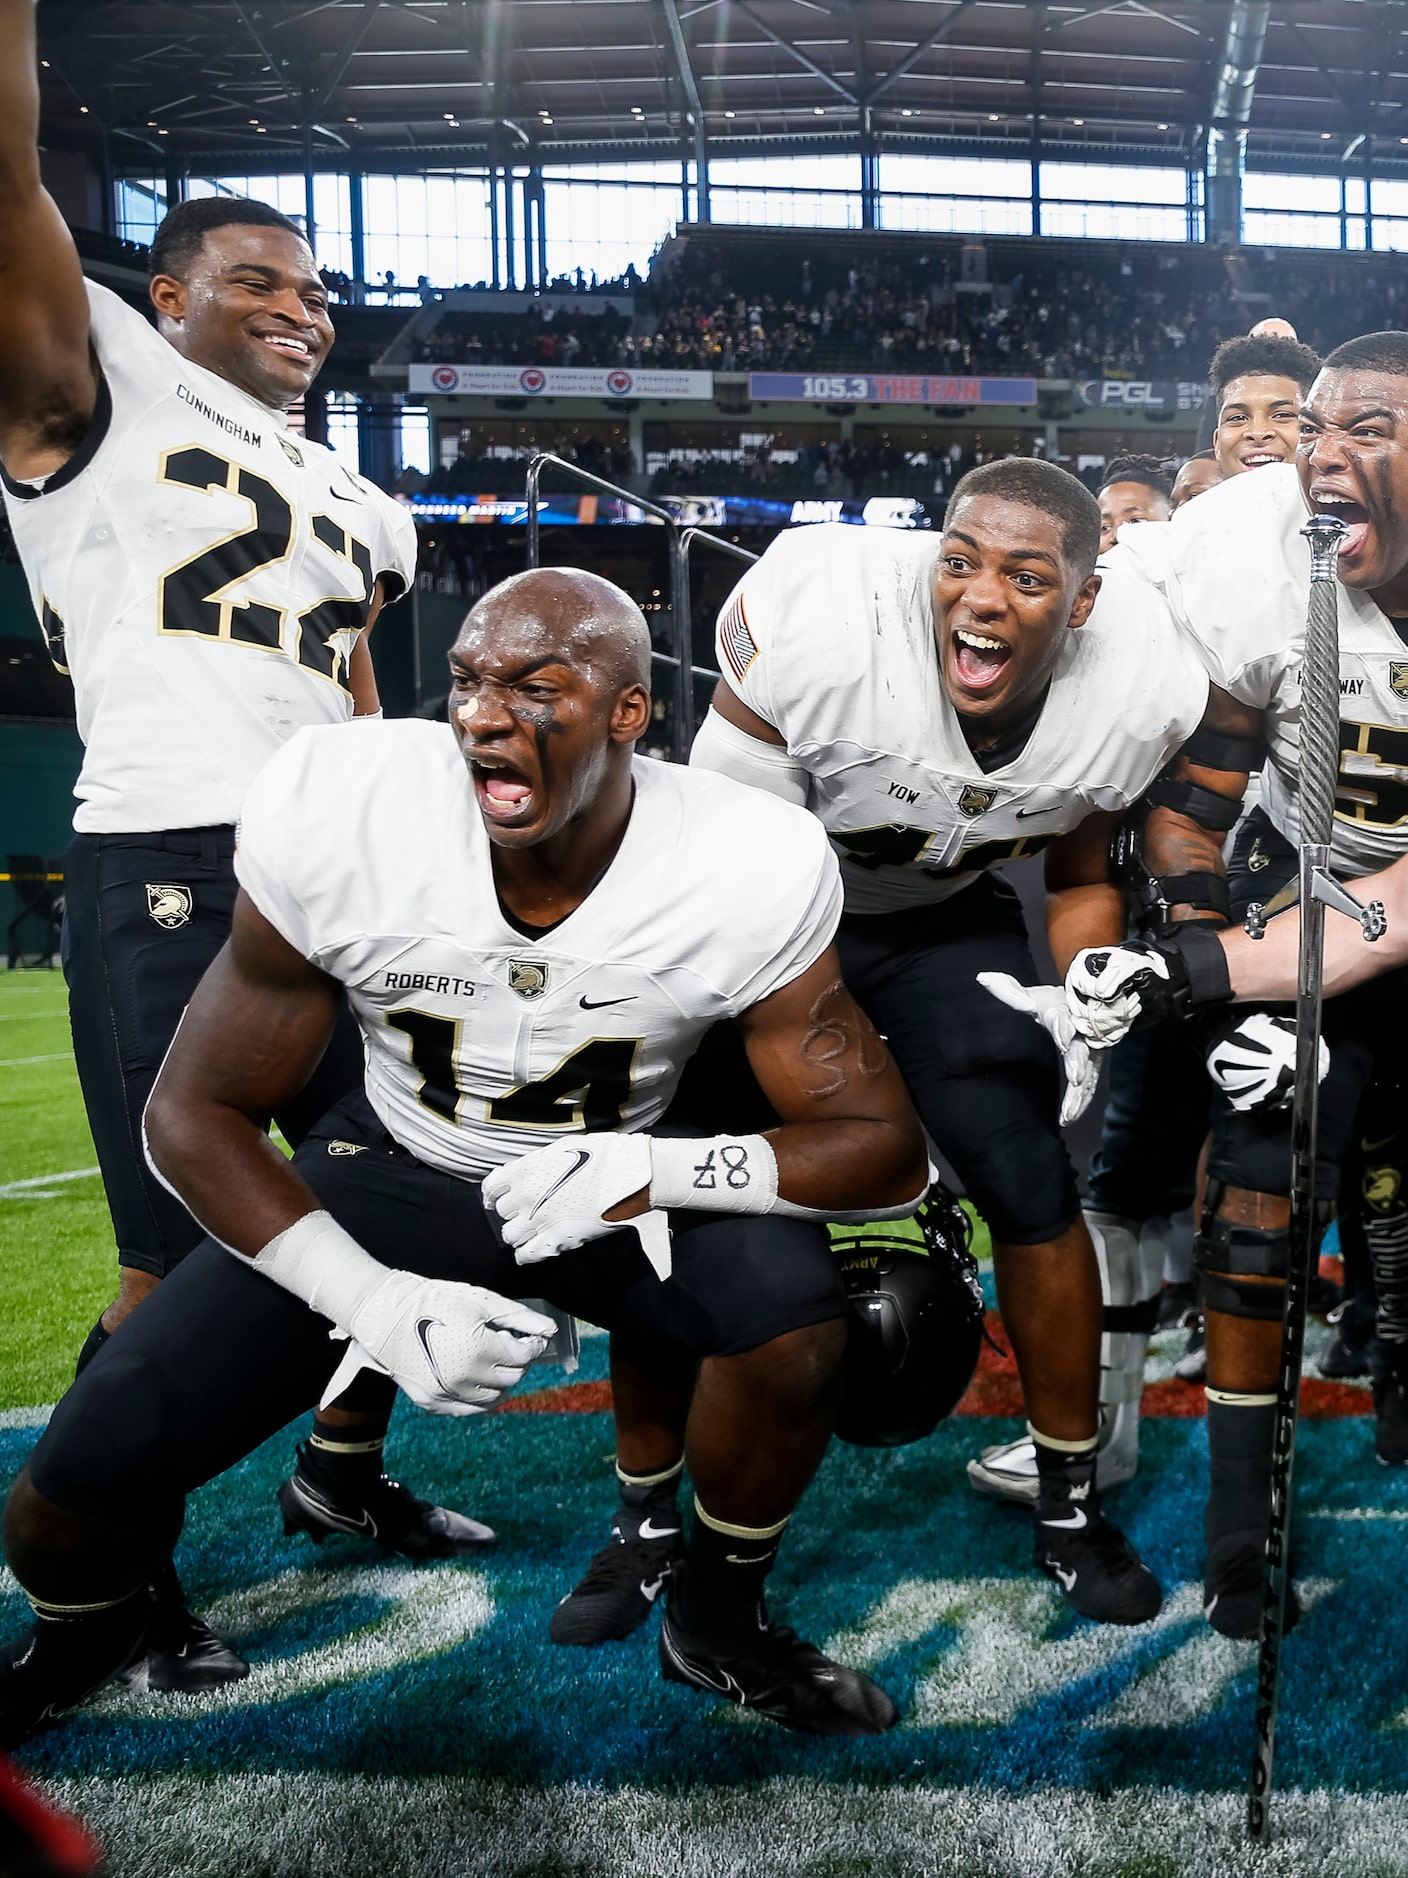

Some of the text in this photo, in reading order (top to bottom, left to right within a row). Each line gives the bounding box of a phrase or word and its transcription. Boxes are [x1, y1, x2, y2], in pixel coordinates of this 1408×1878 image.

[803, 377, 982, 401] 105.3 THE FAN
[1102, 380, 1165, 404] PGL
[176, 383, 262, 450] CUNNINGHAM
[156, 441, 373, 700] 22
[887, 781, 921, 805] YOW
[385, 971, 477, 998] ROBERTS
[384, 1007, 646, 1132] 14
